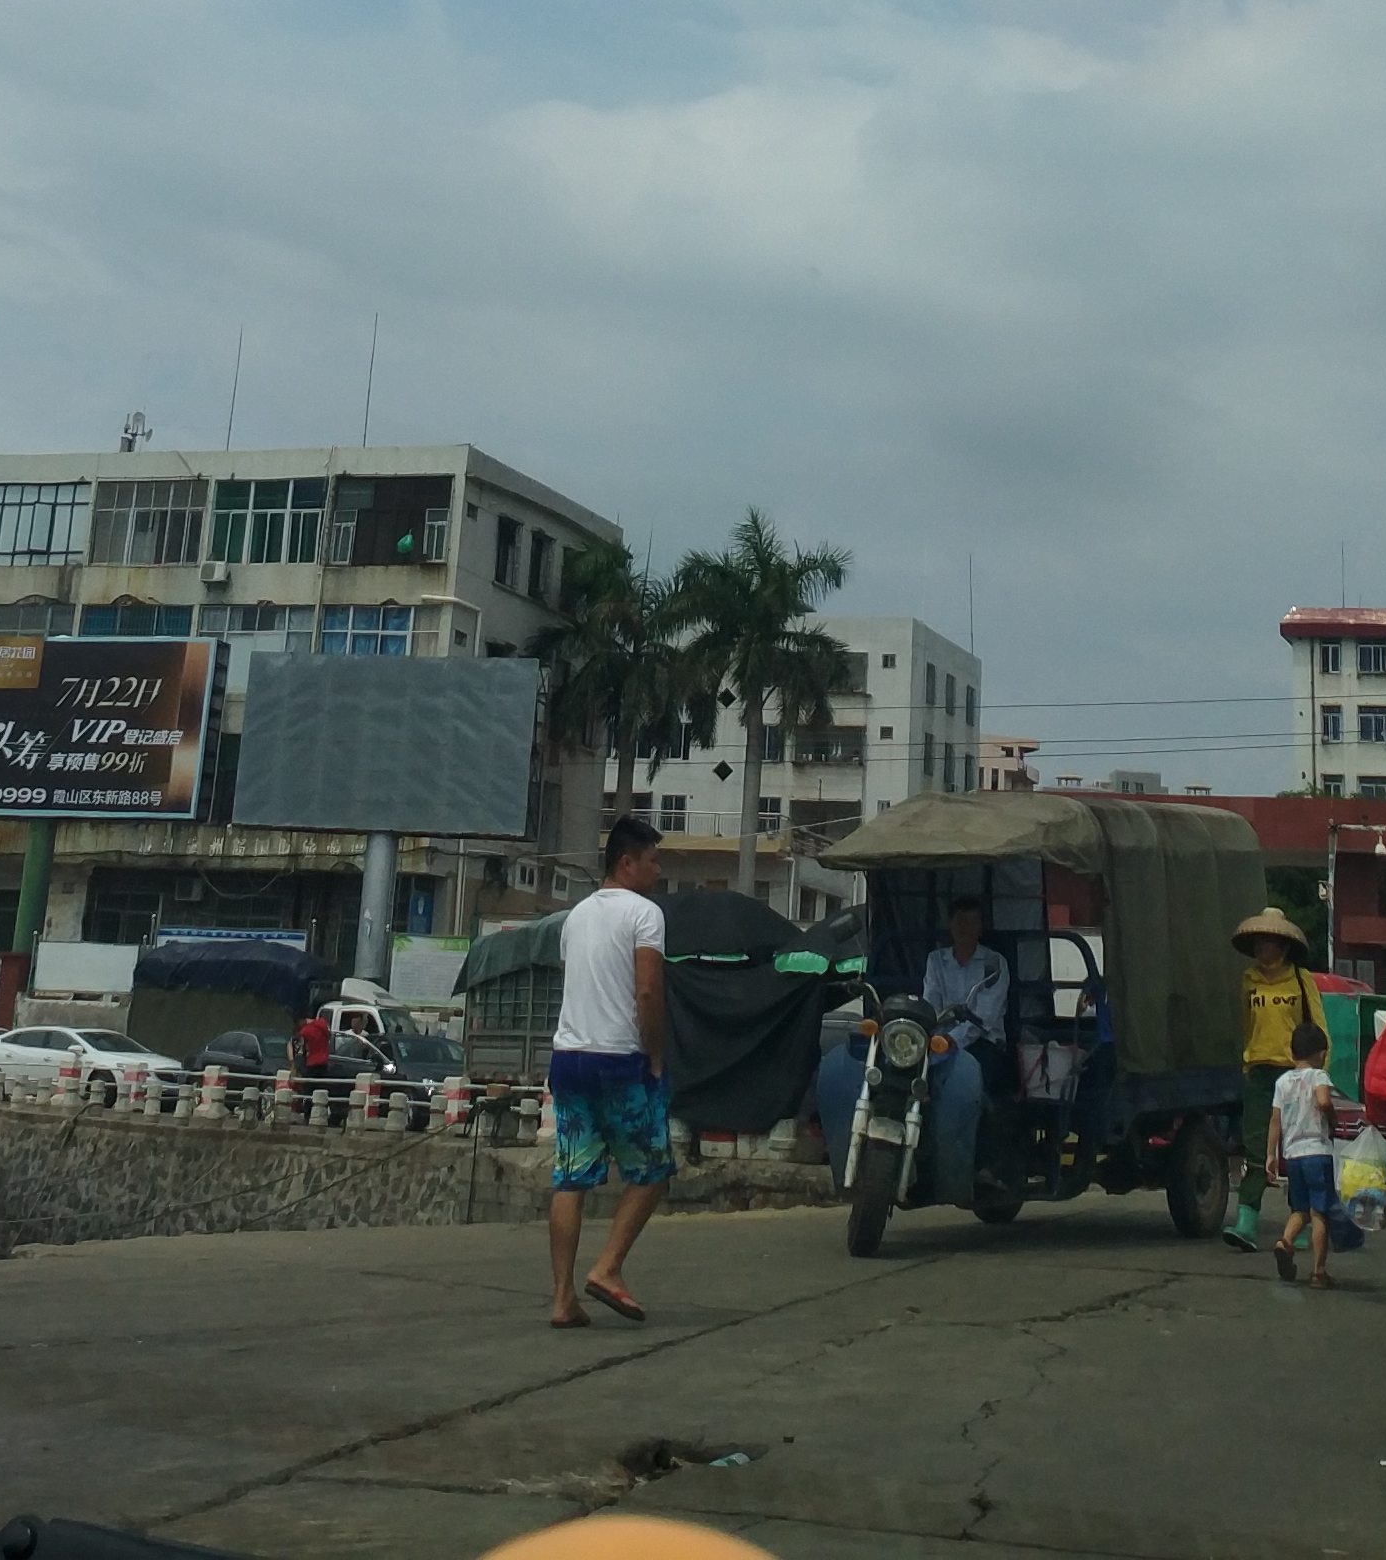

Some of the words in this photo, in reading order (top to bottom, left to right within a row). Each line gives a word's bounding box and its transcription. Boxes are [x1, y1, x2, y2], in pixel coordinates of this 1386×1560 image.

[54, 676, 163, 711] 7月22日
[52, 788, 163, 806] 霞山区东新路88号
